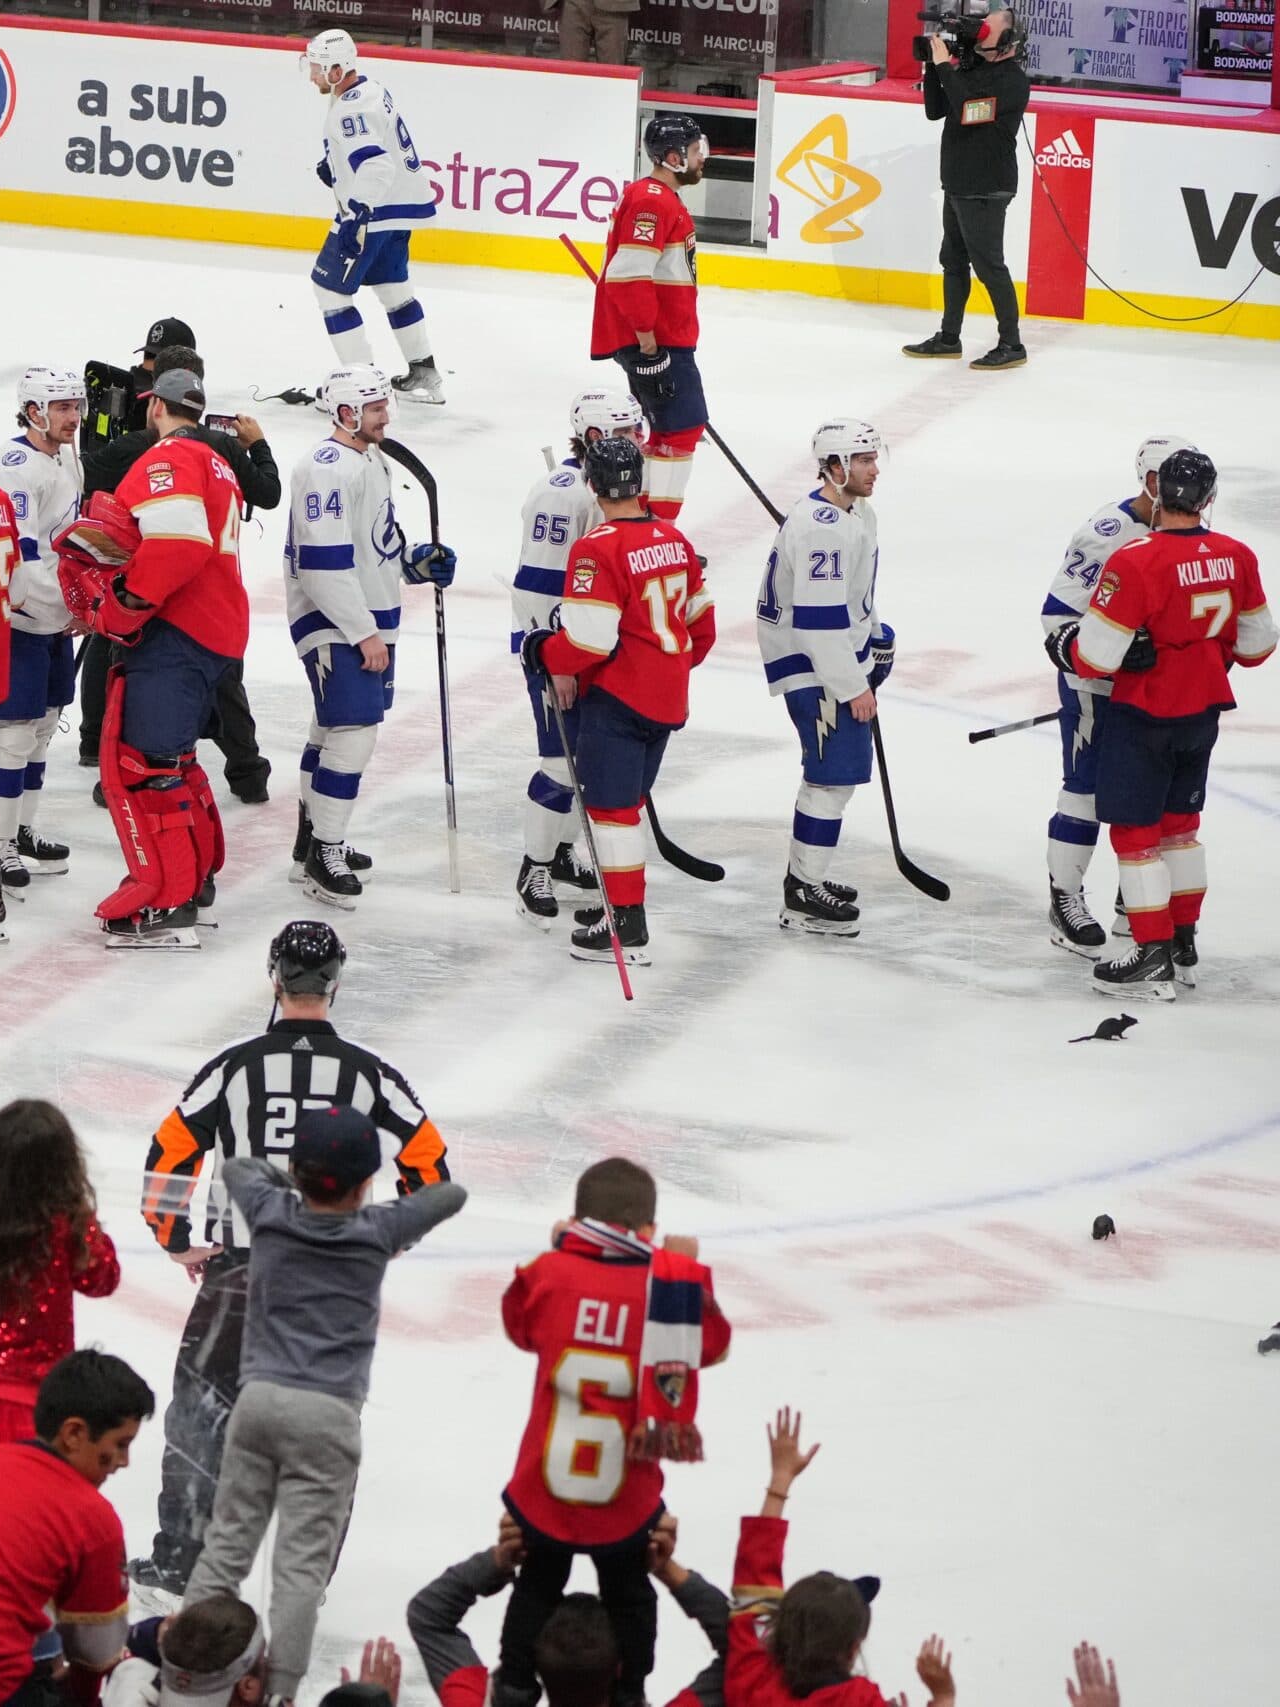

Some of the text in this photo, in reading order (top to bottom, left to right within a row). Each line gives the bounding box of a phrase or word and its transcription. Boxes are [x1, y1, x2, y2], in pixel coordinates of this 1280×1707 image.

[293, 0, 363, 15] HAIRCLUB
[412, 8, 482, 26] HAIRCLUB
[1139, 9, 1188, 31] TROPIC
[704, 35, 774, 54] HAIRCLUB
[1093, 50, 1136, 66] TROPICAL
[1091, 63, 1136, 79] FINANCIAL
[77, 76, 227, 128] a sub
[341, 112, 370, 138] 91
[65, 125, 234, 187] above
[1036, 152, 1092, 169] adidas
[420, 151, 629, 223] straZe
[647, 184, 663, 195] 5
[621, 470, 631, 481] 17
[305, 488, 343, 523] 84
[1177, 487, 1184, 497] 7
[531, 511, 570, 546] 65
[808, 549, 844, 581] 21
[1065, 549, 1104, 590] 24
[1177, 557, 1236, 587] KULIKOV
[640, 570, 693, 656] 17
[1190, 588, 1234, 640] 7
[121, 799, 149, 867] TRUE
[264, 1097, 334, 1148] 2
[574, 1298, 630, 1347] ELI
[542, 1347, 635, 1505] 6
